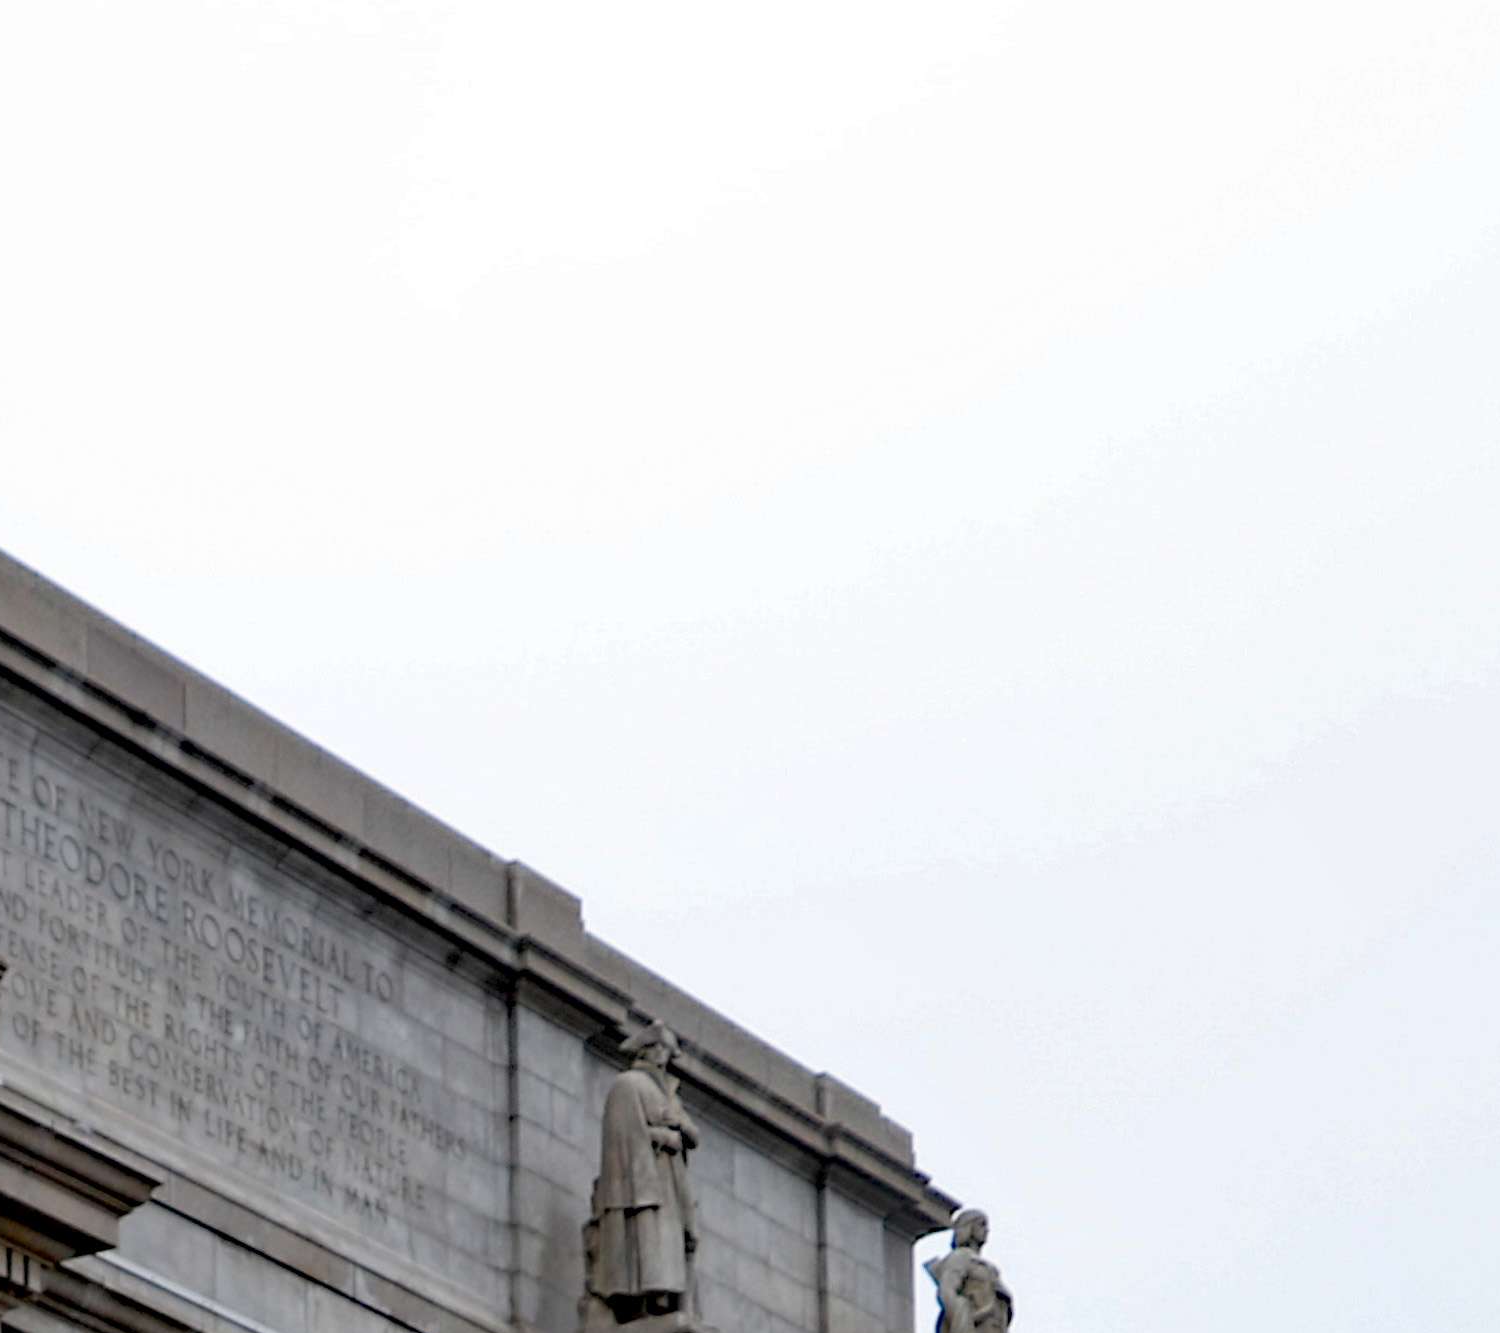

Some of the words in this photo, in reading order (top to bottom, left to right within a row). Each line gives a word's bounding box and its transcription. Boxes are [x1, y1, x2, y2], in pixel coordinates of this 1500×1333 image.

[0, 799, 168, 925] THEODORE
[182, 900, 343, 1019] ROOSEVELT
[24, 860, 108, 929] LEADER
[121, 917, 149, 951] OF
[161, 936, 201, 981] THE
[299, 1013, 323, 1049] OF
[32, 775, 68, 816] OF
[79, 799, 135, 851] NEW
[148, 835, 217, 905] YORK
[228, 884, 354, 984] MEMORIAL
[362, 961, 394, 1003] TO
[11, 971, 57, 1018] OVE
[12, 1011, 43, 1050] OF
[56, 1030, 98, 1076] THE
[107, 1059, 160, 1108] BEST
[111, 984, 151, 1029] THE
[163, 1012, 244, 1077] RIGHTS
